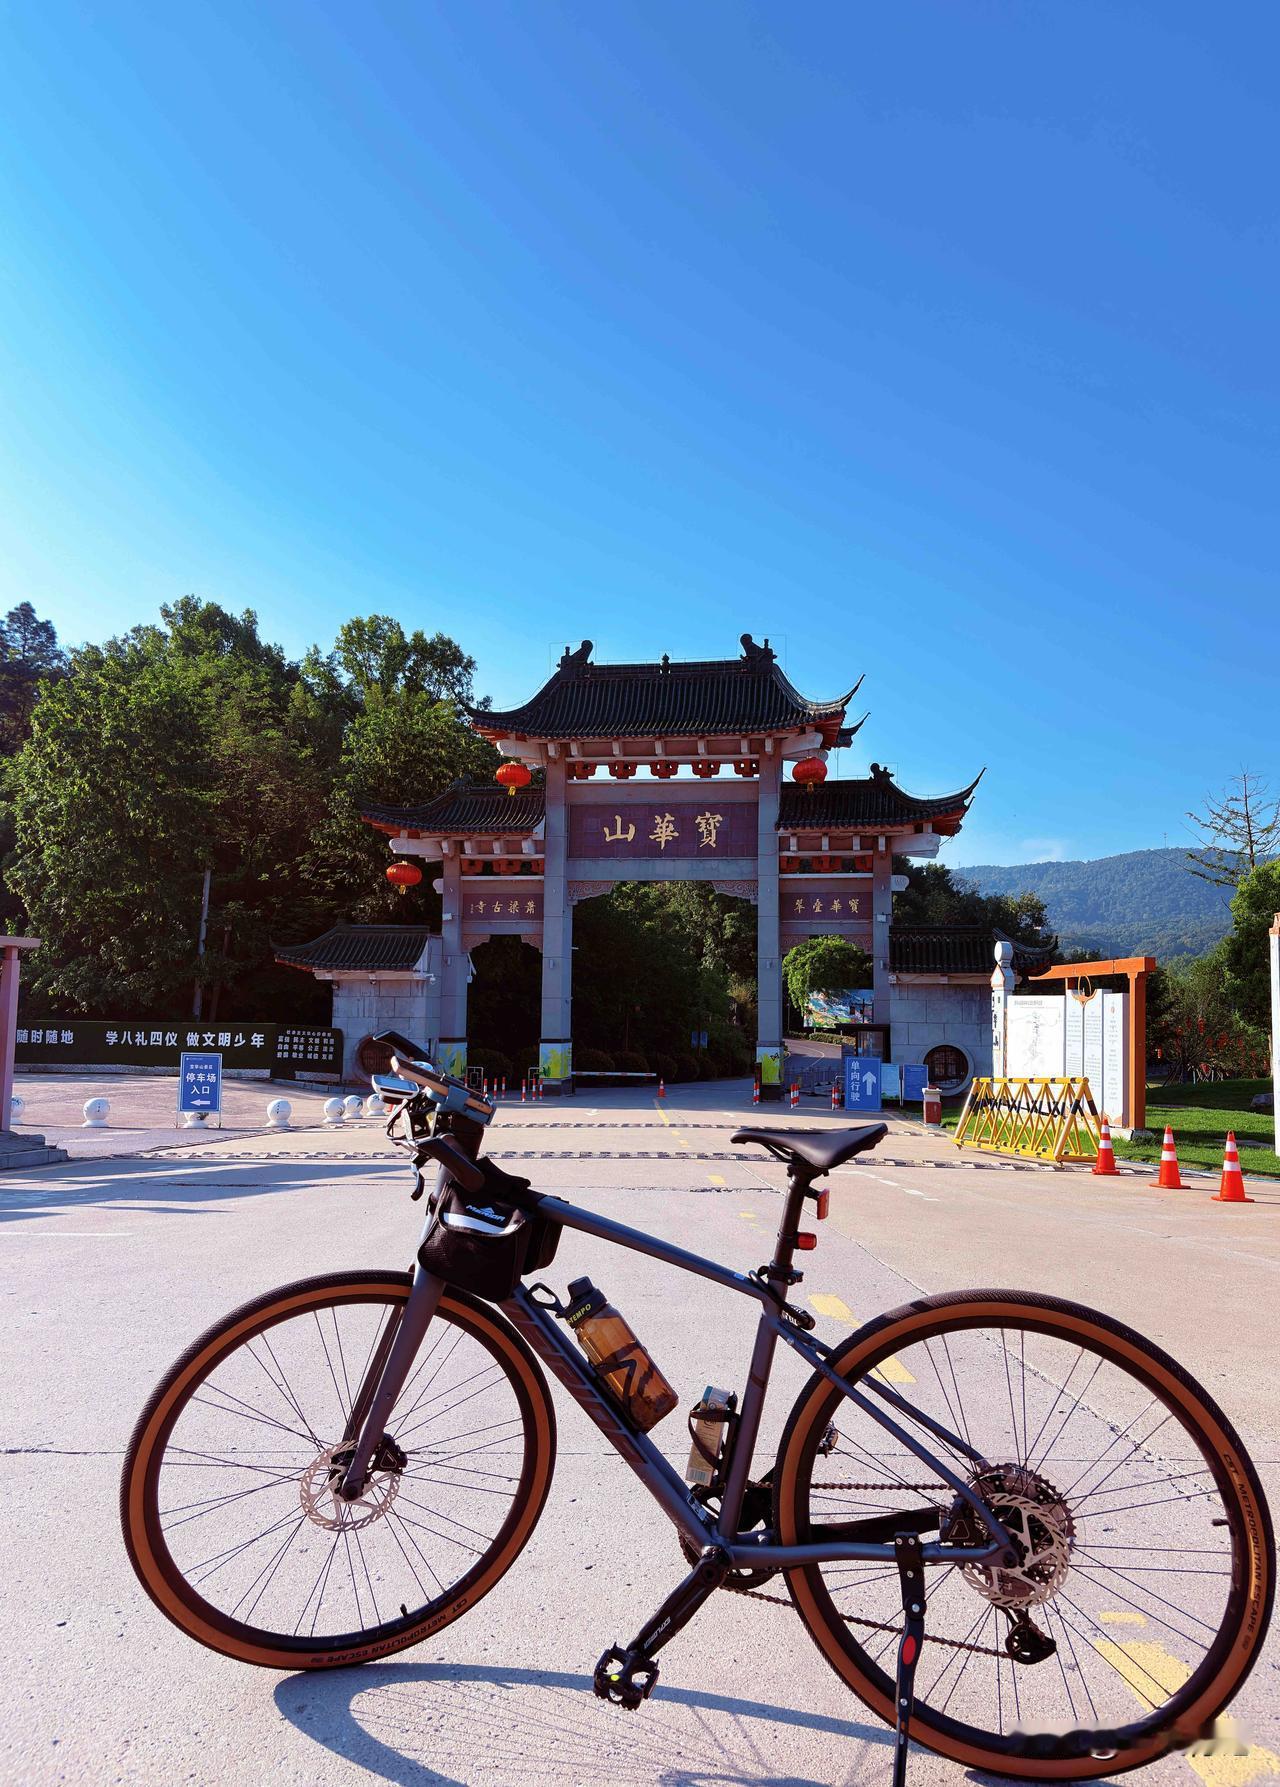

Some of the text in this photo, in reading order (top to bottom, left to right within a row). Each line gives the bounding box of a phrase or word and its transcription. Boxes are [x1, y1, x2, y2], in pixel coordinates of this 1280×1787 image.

[16, 1029, 265, 1048] 随时随地 学八礼四仪 做文明少年
[186, 1073, 217, 1083] 停车场
[850, 1060, 860, 1101] 单向行驶
[191, 1085, 210, 1095] 入口
